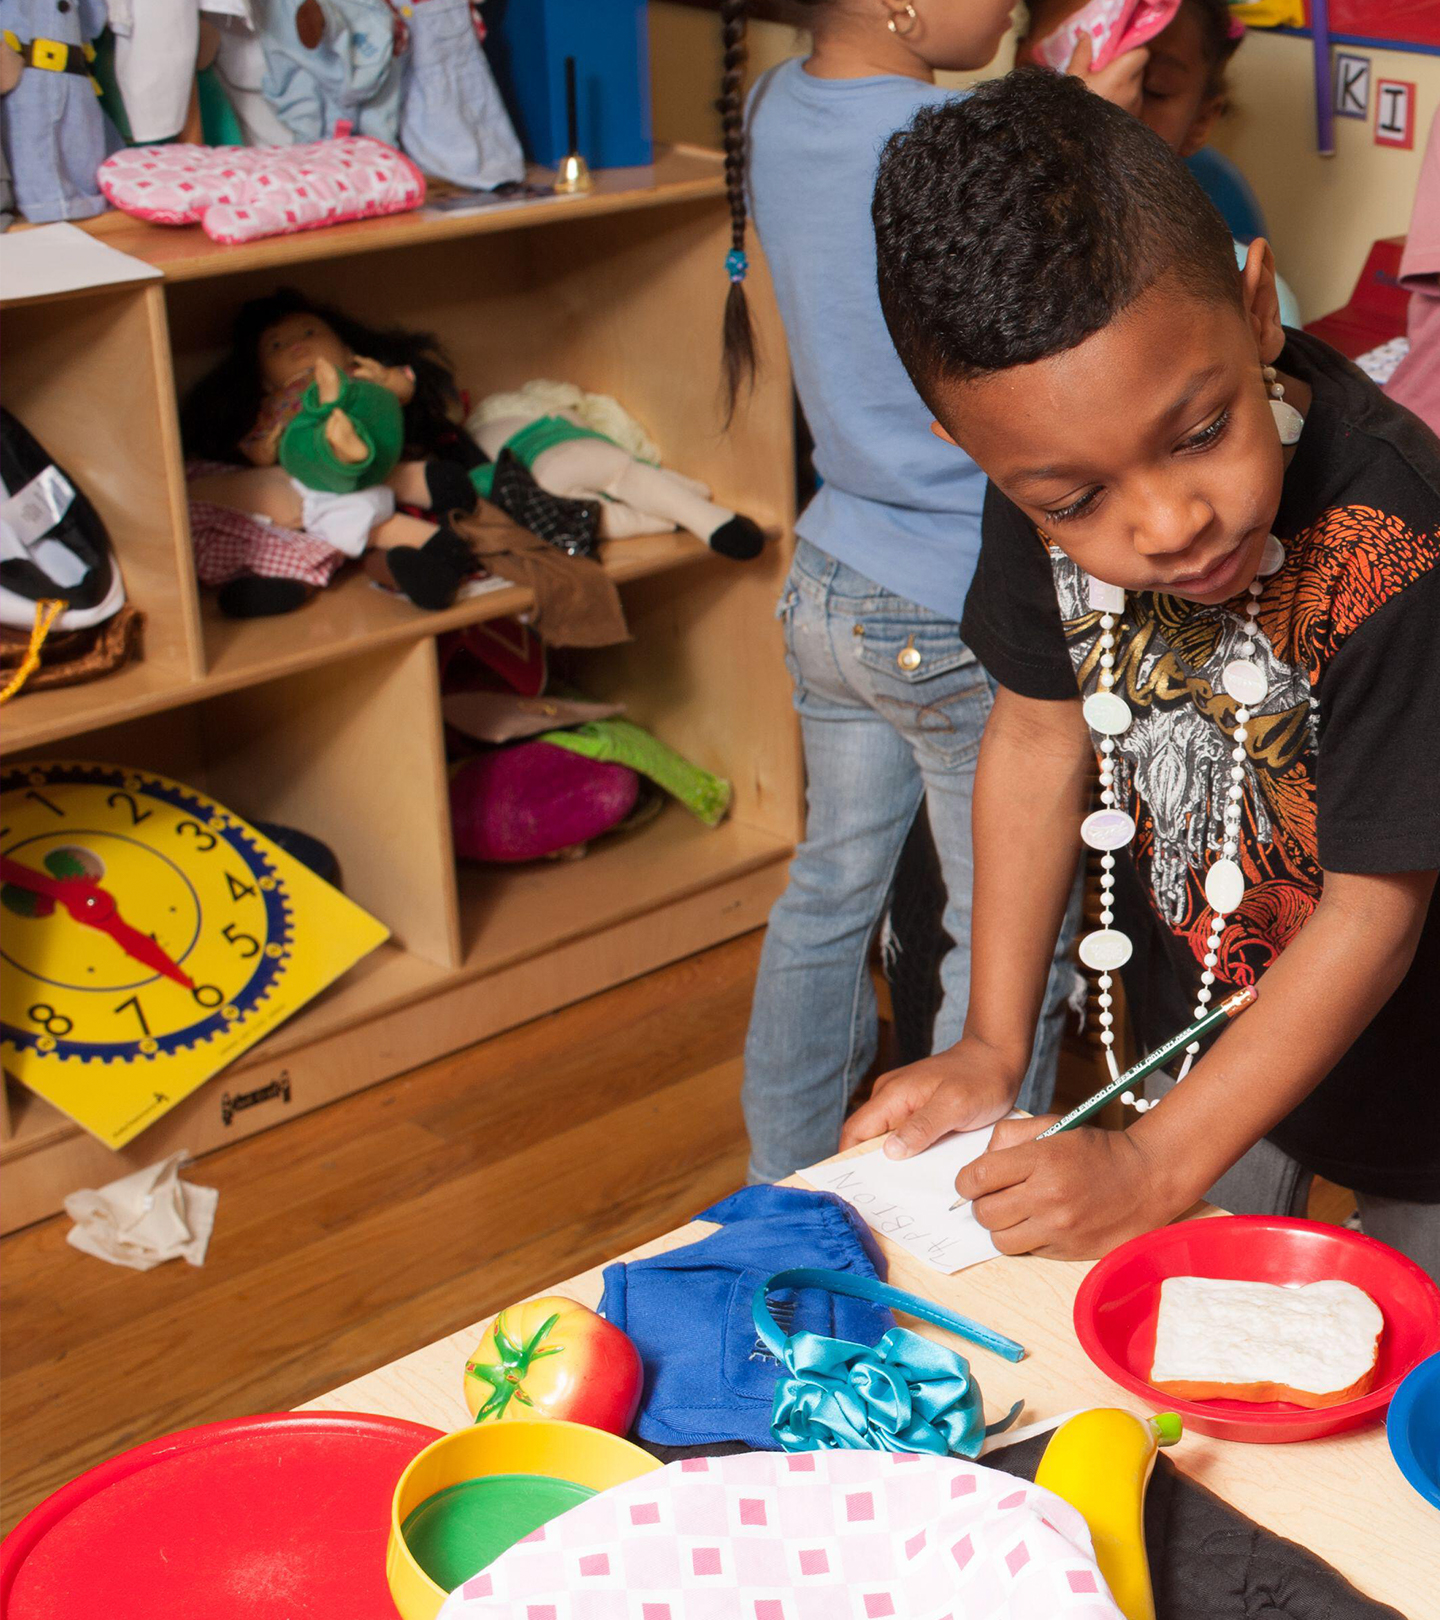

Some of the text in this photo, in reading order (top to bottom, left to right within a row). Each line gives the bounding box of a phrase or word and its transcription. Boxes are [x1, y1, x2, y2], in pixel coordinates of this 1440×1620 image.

[1341, 63, 1367, 110] K
[1380, 88, 1405, 132] I
[26, 791, 65, 817] 1
[107, 792, 152, 825] 2
[176, 821, 217, 851] 3
[224, 870, 257, 902] 4
[221, 923, 260, 959] 5
[189, 975, 224, 1008] 6
[27, 1003, 73, 1036] 8
[114, 995, 150, 1035] 7
